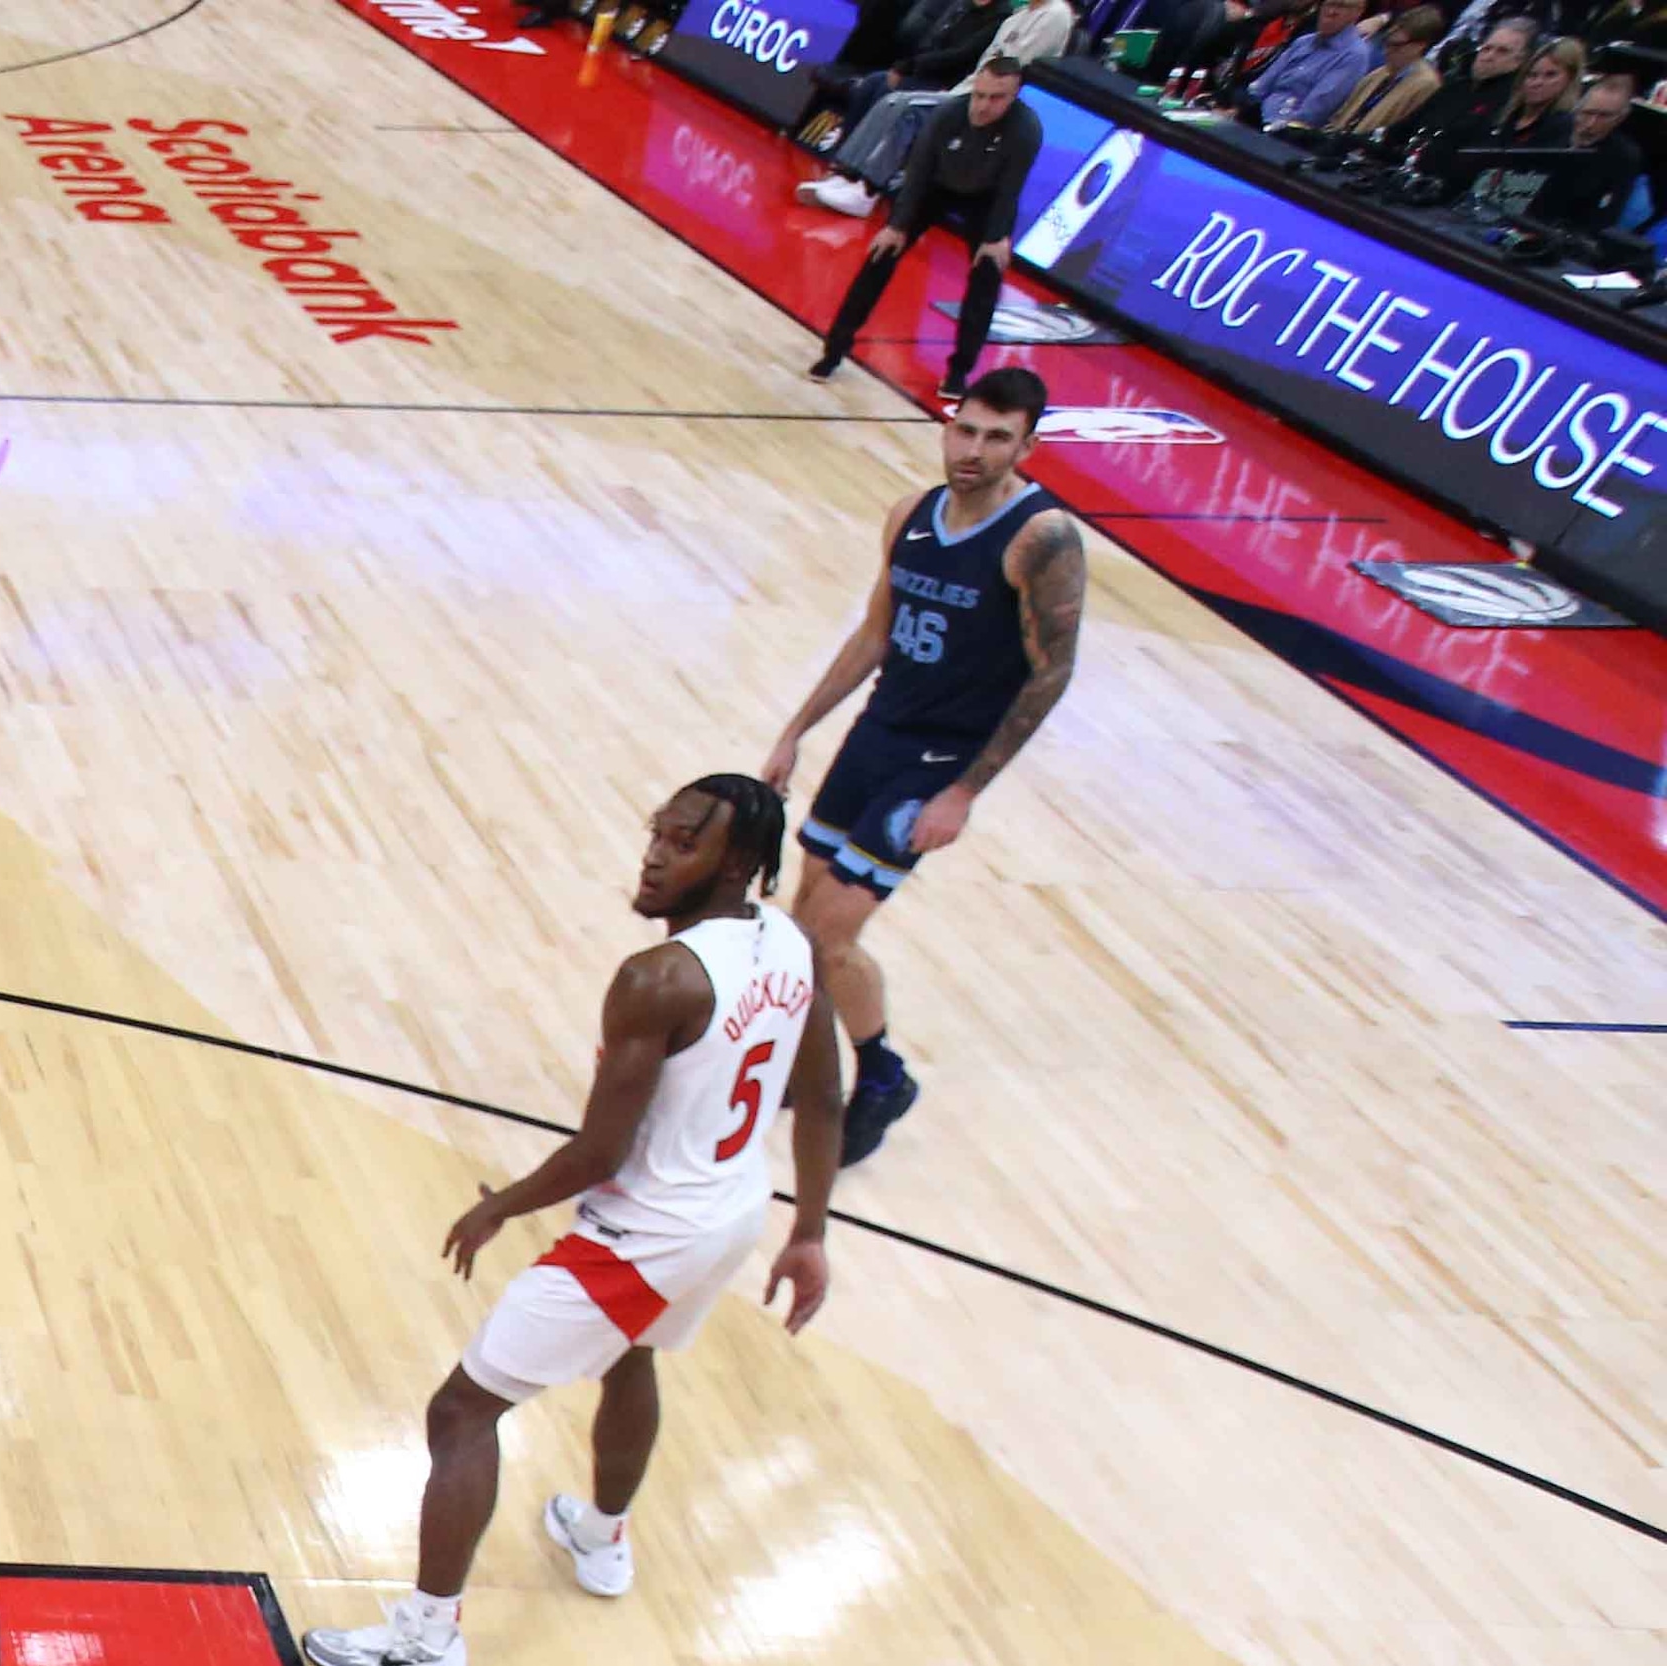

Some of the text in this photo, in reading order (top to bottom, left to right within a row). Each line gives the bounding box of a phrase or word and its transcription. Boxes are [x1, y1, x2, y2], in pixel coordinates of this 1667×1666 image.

[2, 114, 173, 224] Arena
[126, 117, 461, 346] Scotiabank
[1151, 210, 1667, 519] ROC THE HOUSE
[891, 603, 948, 664] 46
[714, 1038, 775, 1163] 5
